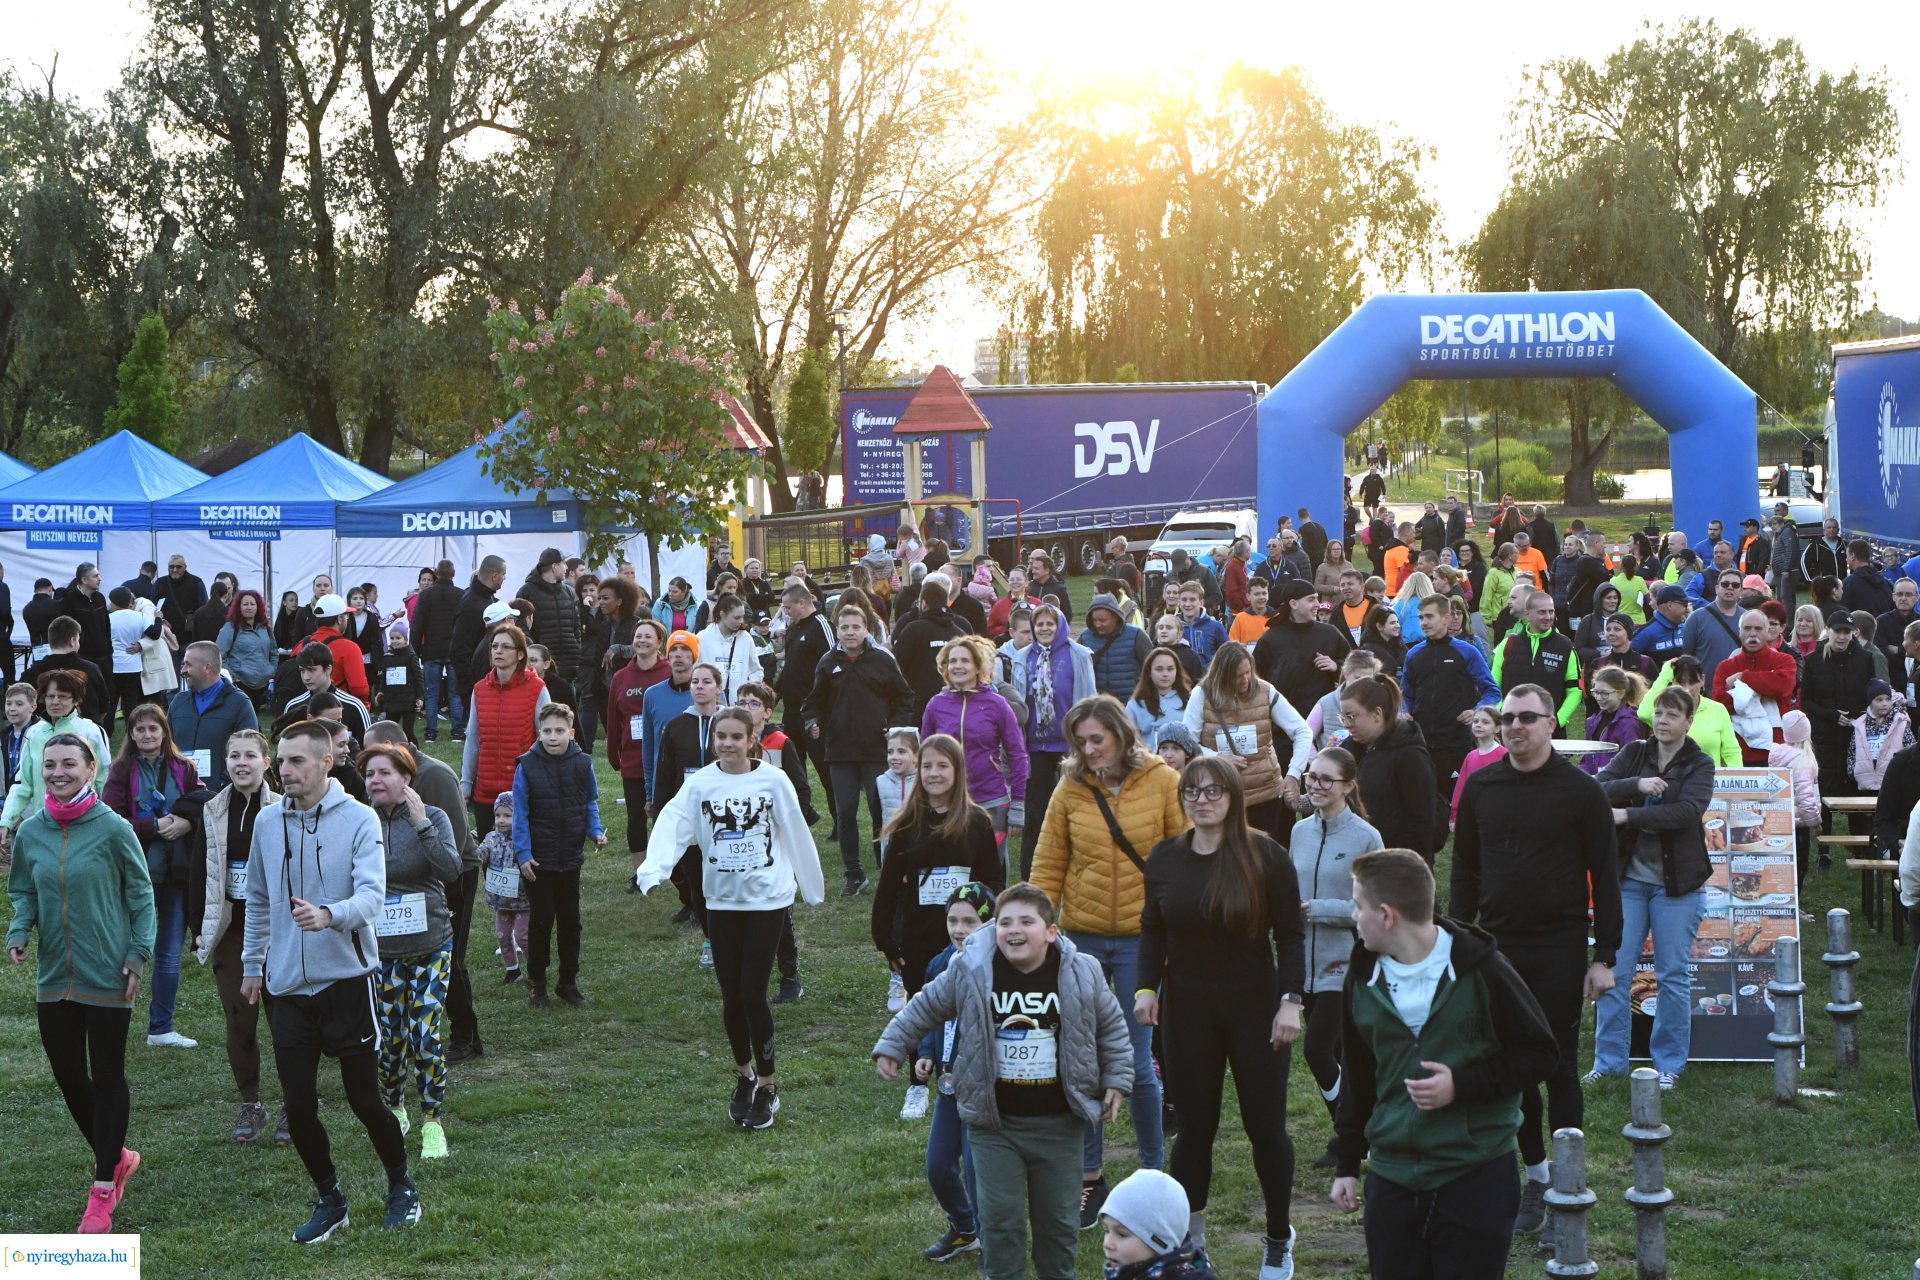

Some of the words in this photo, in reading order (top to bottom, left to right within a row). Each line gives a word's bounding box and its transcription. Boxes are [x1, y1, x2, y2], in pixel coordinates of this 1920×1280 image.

[1420, 311, 1616, 345] DECATHLON
[1420, 345, 1500, 361] SPORTBÓL
[1509, 347, 1517, 359] A
[1526, 343, 1616, 359] LEGTÖBBET
[1074, 418, 1160, 479] DSV
[12, 503, 113, 525] DECATHLON
[200, 505, 281, 520] DECATHLON
[402, 509, 511, 532] DECATHLON
[1541, 651, 1564, 661] UNCLE
[1543, 659, 1559, 668] SAM
[1721, 777, 1759, 789] AJÁNLATA
[728, 841, 755, 854] 1325
[230, 872, 247, 884] 127
[490, 872, 508, 885] 1770
[931, 877, 958, 889] 1759
[385, 907, 412, 920] 1278
[1738, 962, 1755, 972] KÁVÉ
[991, 991, 1060, 1015] NASA
[1003, 1045, 1039, 1060] 1287
